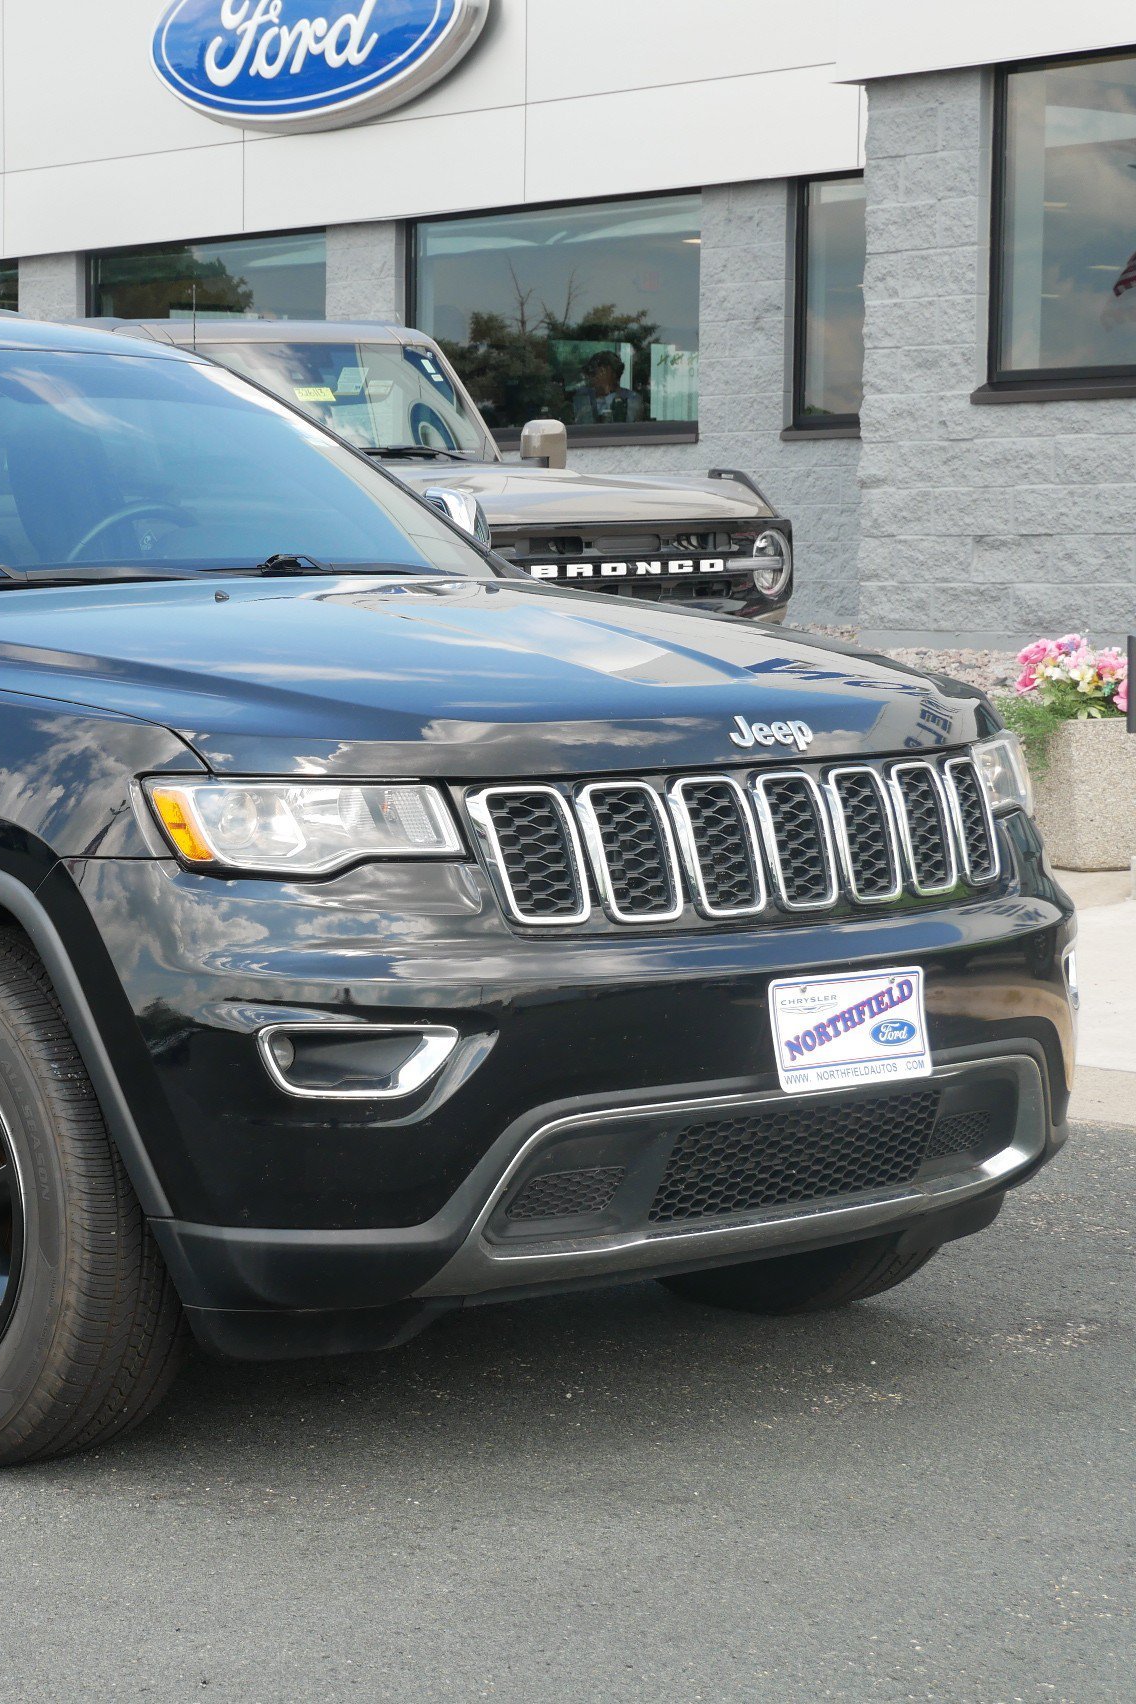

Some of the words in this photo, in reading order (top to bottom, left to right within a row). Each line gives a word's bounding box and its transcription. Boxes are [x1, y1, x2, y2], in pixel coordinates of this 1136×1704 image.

[205, 0, 378, 87] Ford
[530, 558, 724, 579] BRONCO
[728, 715, 814, 752] Jeep
[780, 994, 838, 1006] CHRYSLER
[784, 978, 914, 1062] NORTHFIELD
[878, 1023, 909, 1041] Ford
[1, 1060, 25, 1099] ALL
[784, 1073, 812, 1085] WWW.
[816, 1062, 898, 1082] NORTHFIELDAUTOS
